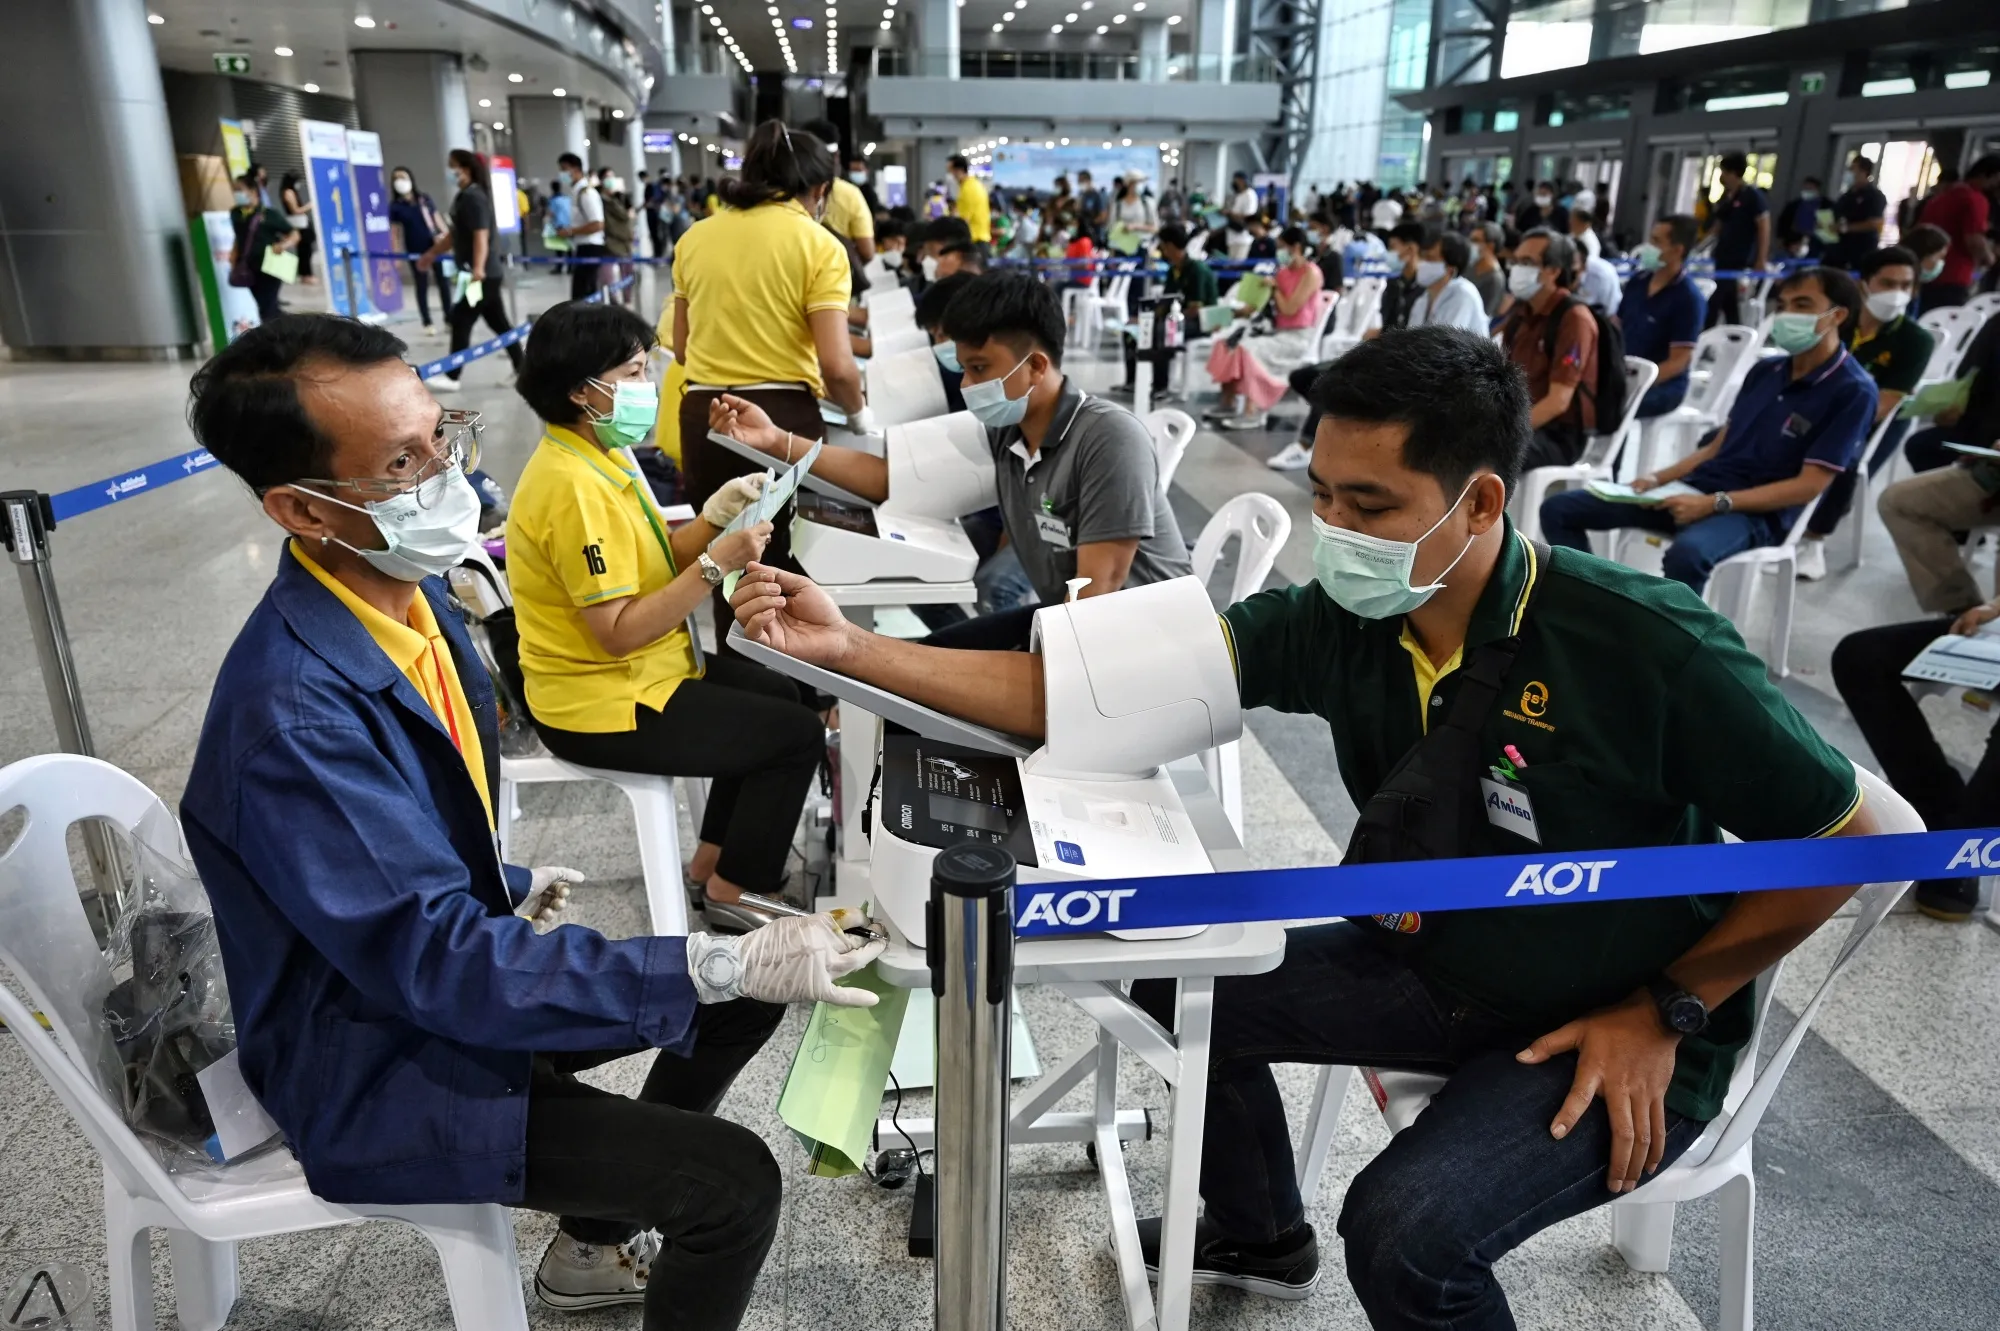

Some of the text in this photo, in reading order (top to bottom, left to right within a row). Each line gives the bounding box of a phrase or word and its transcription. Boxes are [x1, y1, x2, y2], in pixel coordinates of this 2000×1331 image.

[331, 186, 344, 224] 1
[1505, 860, 1618, 897] AOT
[1016, 889, 1138, 928] AOT
